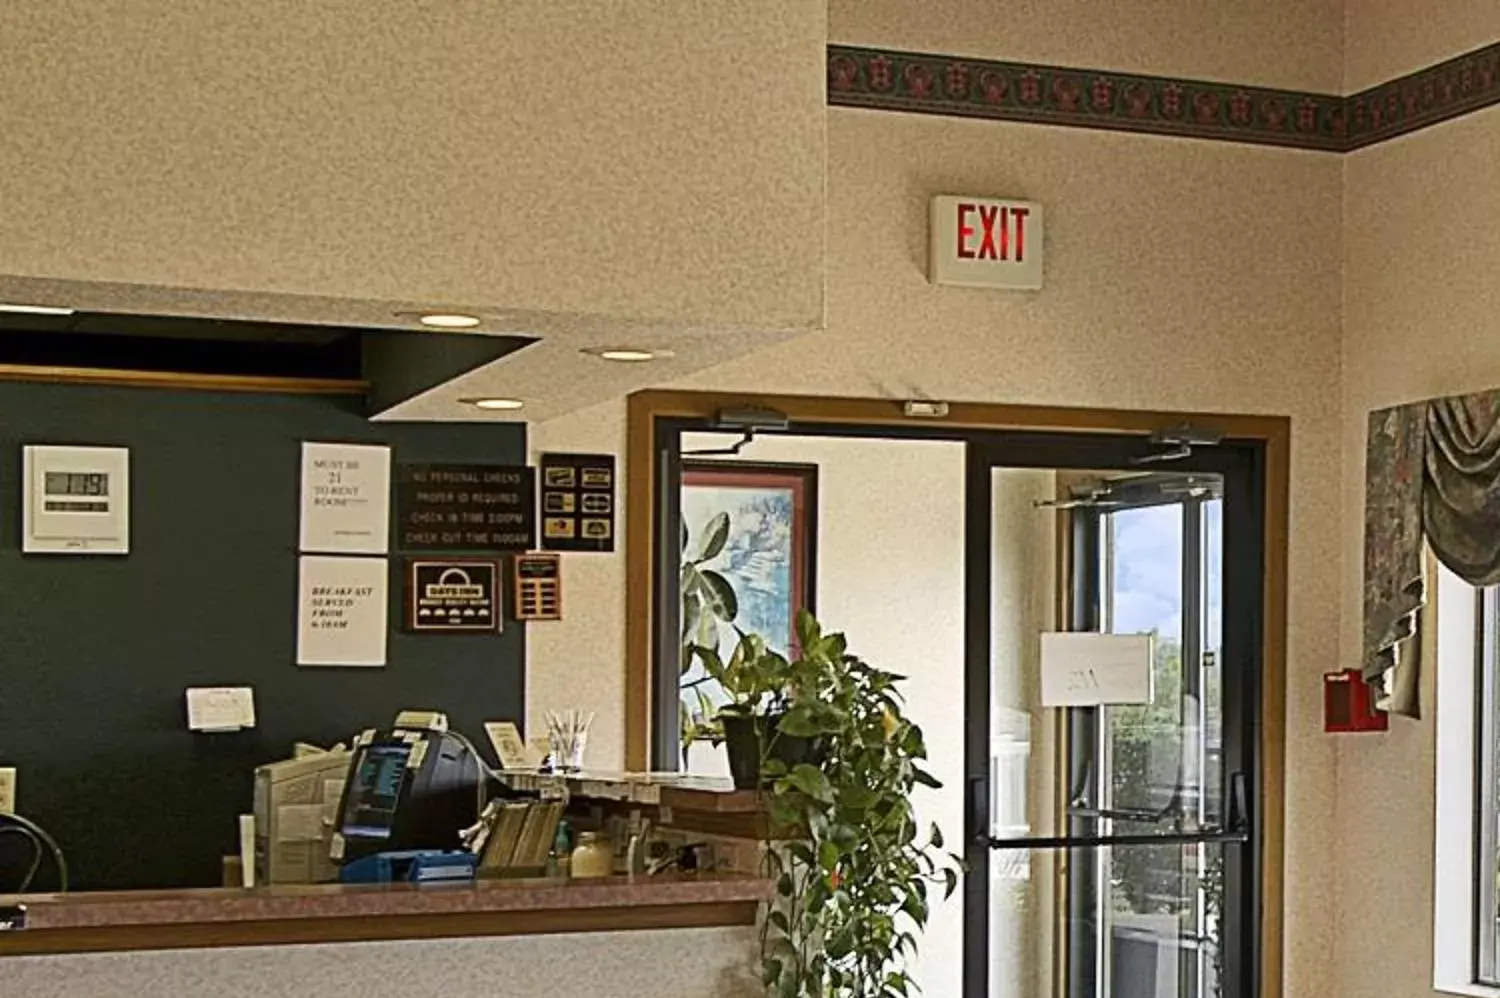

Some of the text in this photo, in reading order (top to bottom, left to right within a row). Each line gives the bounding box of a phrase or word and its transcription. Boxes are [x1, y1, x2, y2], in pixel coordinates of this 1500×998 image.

[957, 203, 1030, 262] EXIT
[328, 472, 342, 485] 21
[312, 587, 374, 597] BREAKFAST
[429, 586, 459, 597] DAYS
